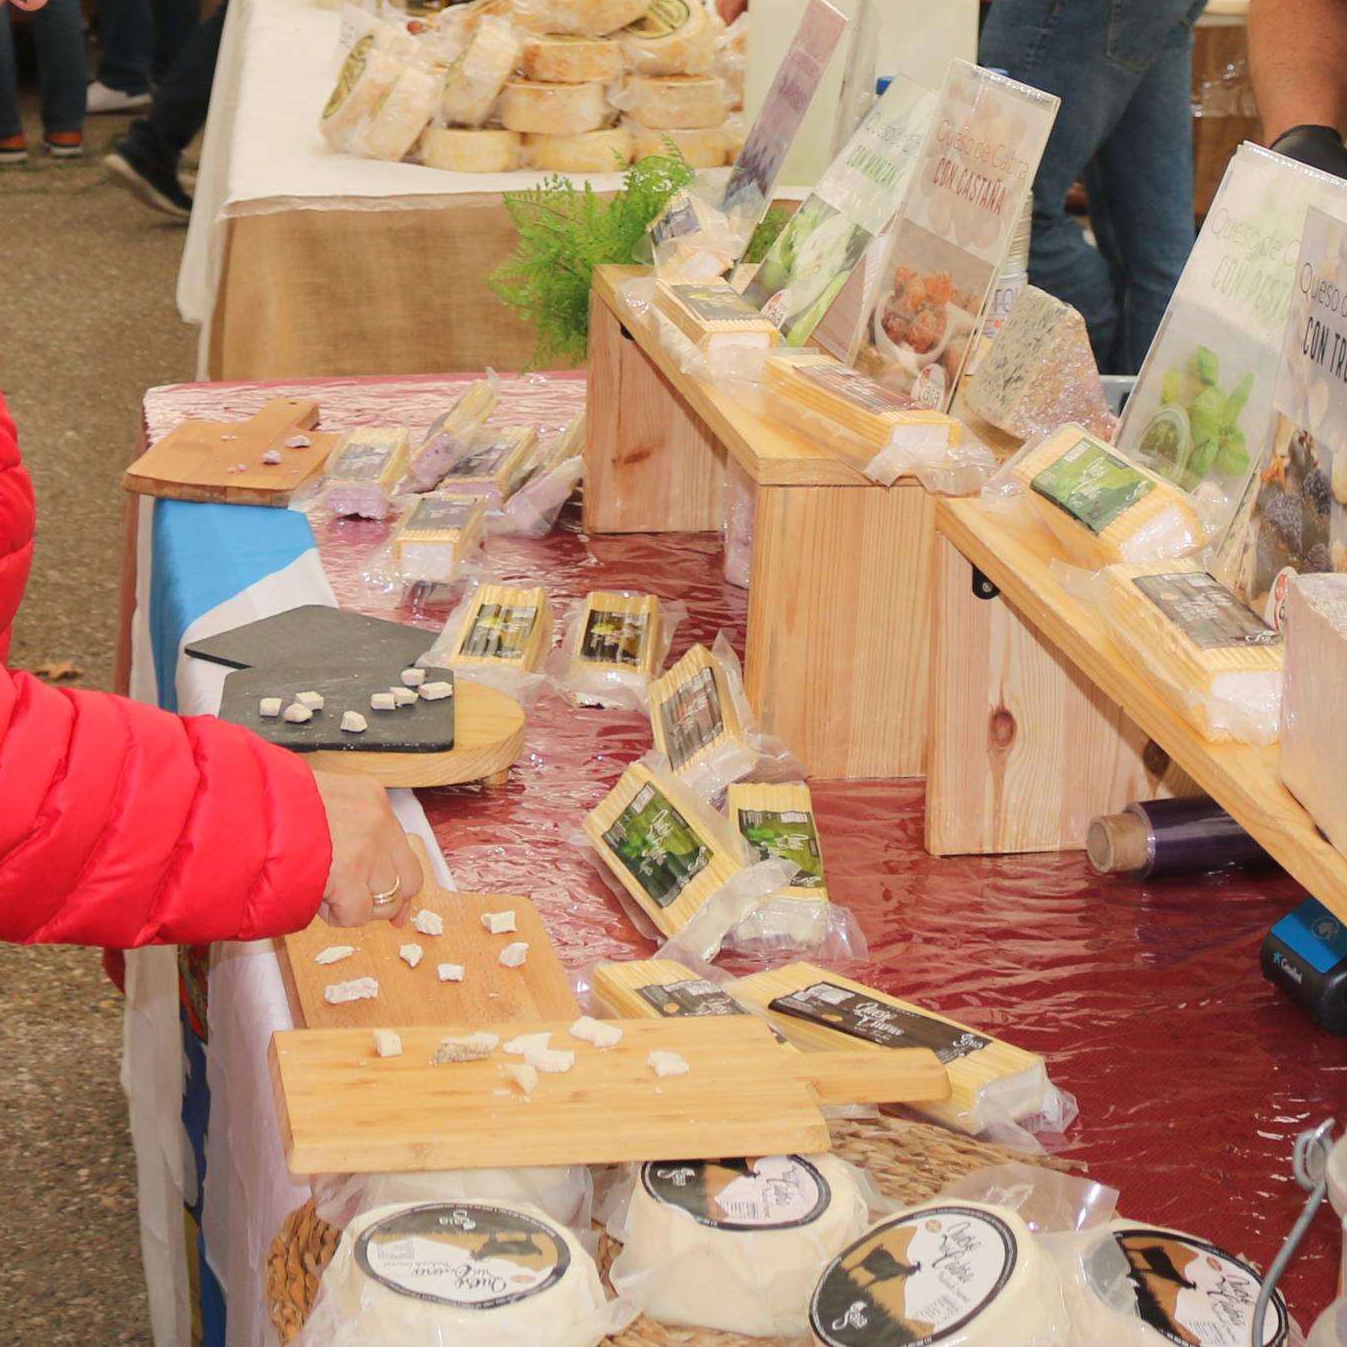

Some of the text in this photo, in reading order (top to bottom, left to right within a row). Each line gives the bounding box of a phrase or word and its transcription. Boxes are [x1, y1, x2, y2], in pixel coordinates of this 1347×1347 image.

[932, 157, 961, 190] CON
[936, 118, 974, 156] Queso
[991, 143, 1030, 181] Cabra
[1299, 262, 1341, 313] Queso
[1302, 316, 1330, 366] CON
